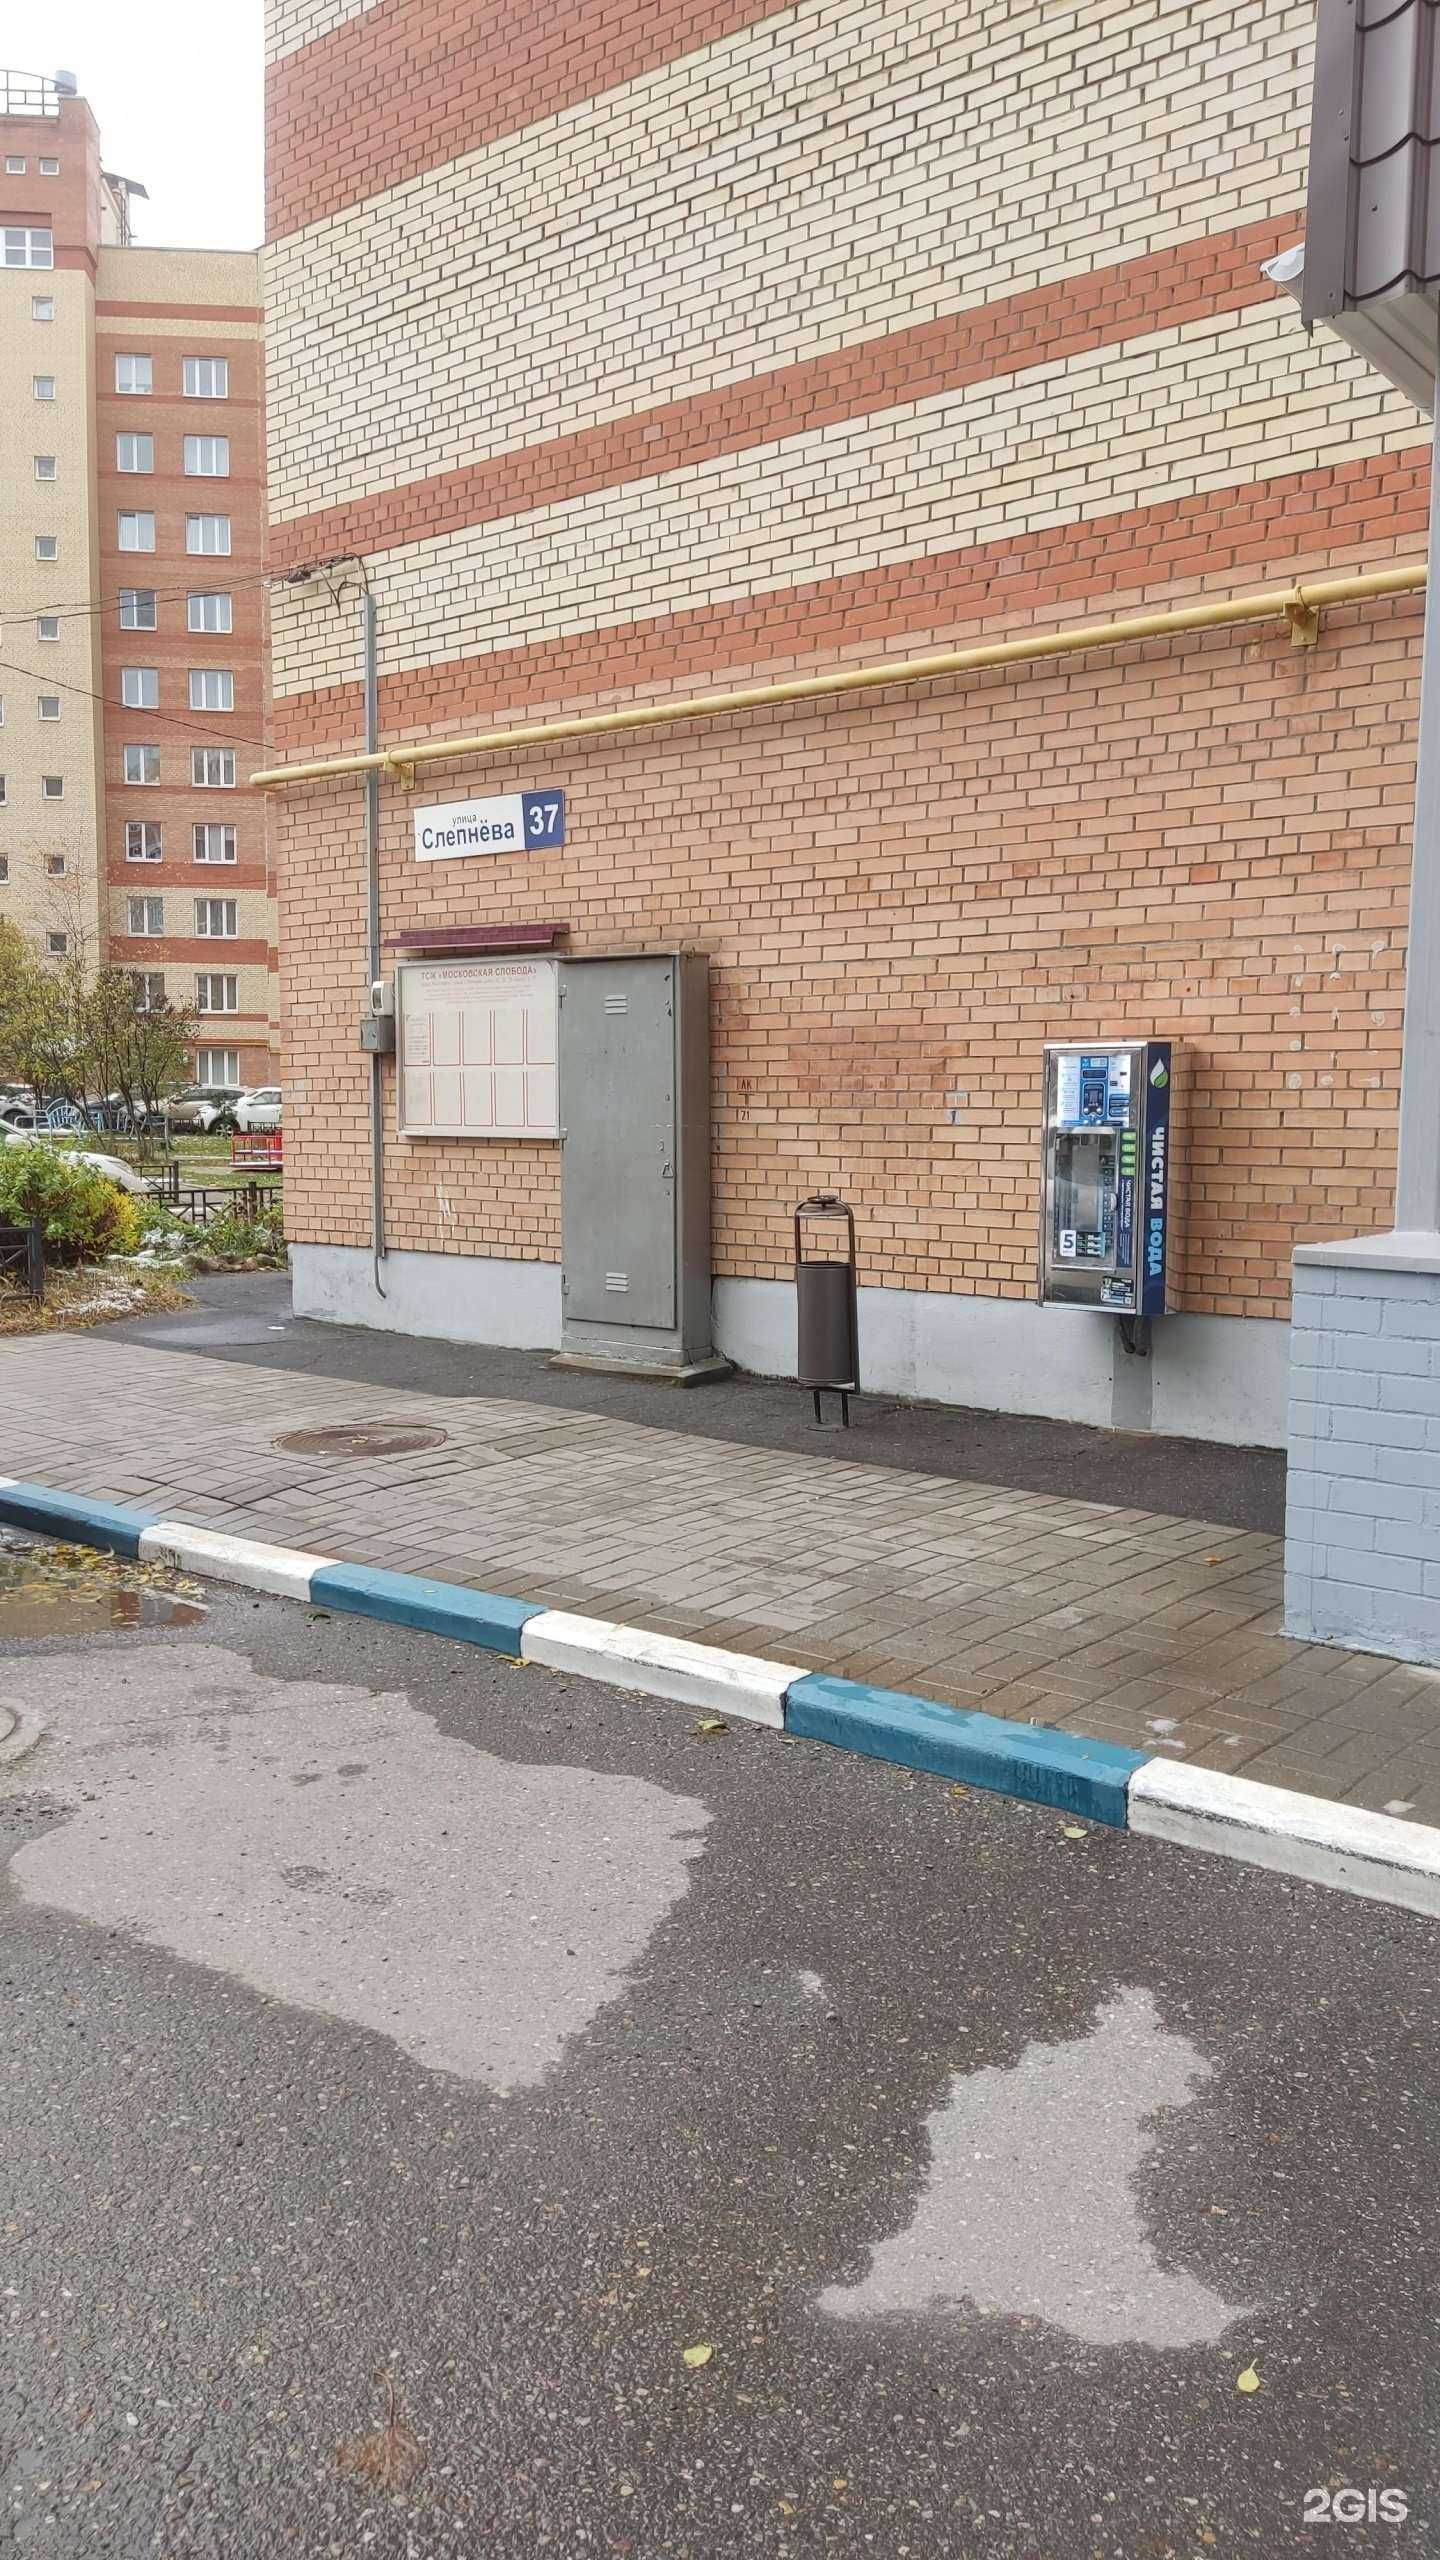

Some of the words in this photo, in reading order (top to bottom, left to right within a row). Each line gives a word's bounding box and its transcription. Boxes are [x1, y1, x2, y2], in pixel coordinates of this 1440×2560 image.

[422, 819, 515, 849] Слепнёва
[452, 814, 477, 827] улица
[529, 803, 559, 836] 37
[1150, 1126, 1165, 1210] ЧИСТАЯ
[1063, 1234, 1074, 1249] 5
[1148, 1217, 1163, 1276] ВОДА
